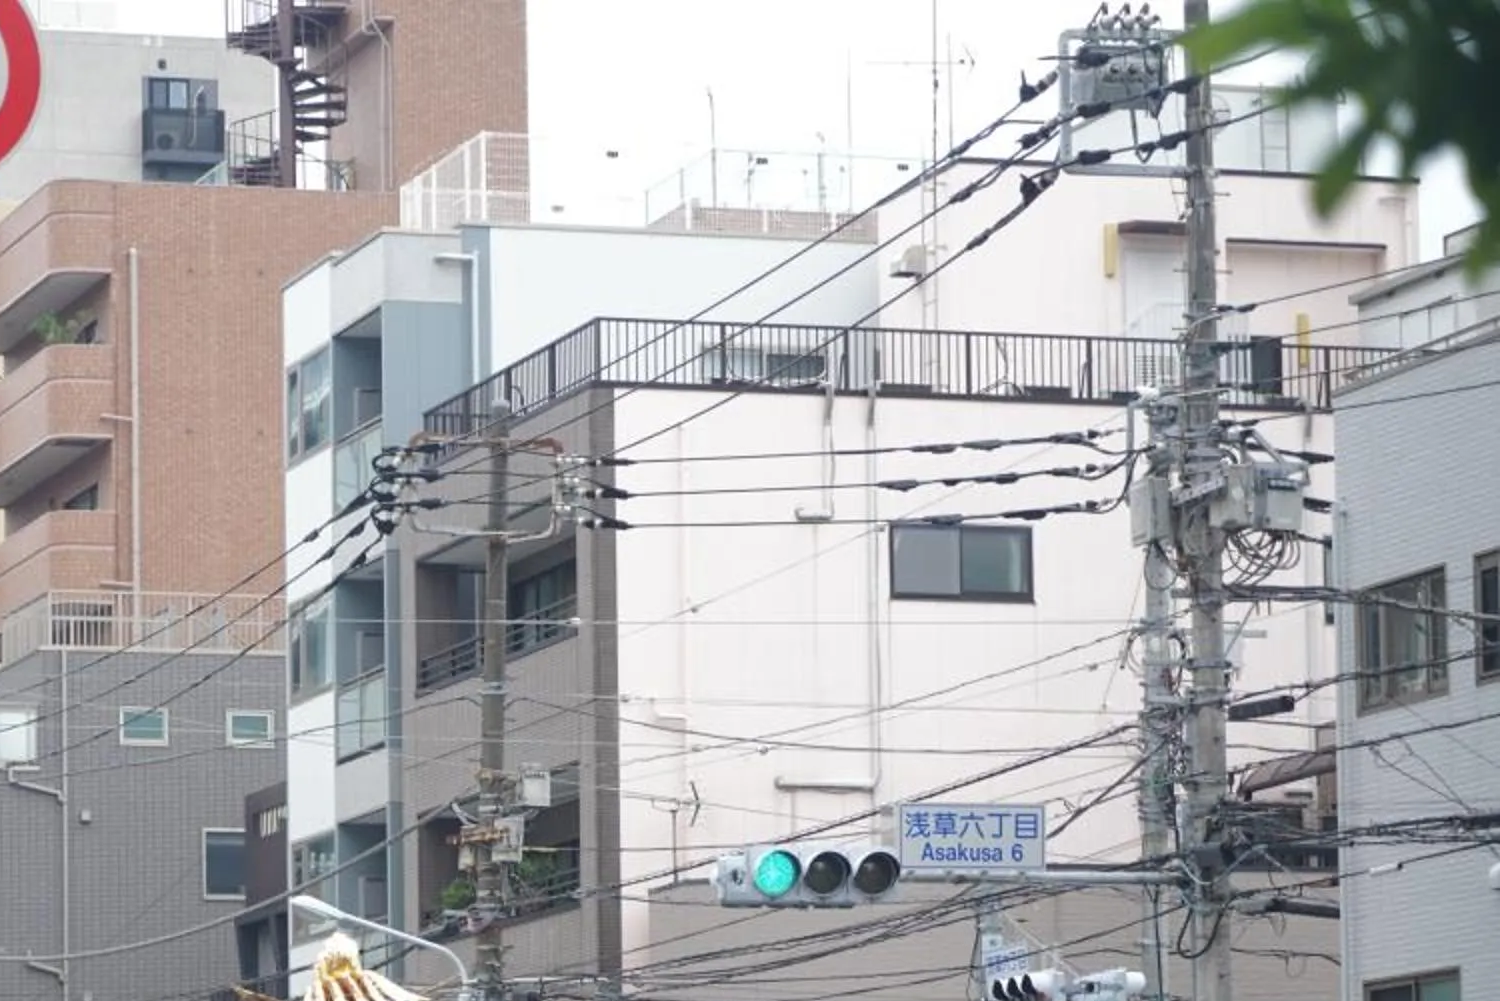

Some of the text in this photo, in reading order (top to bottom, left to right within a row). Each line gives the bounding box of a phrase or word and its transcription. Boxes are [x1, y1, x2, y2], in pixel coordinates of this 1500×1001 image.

[904, 811, 1039, 839] 浅草六丁目
[921, 842, 1024, 862] Asakusa 6
